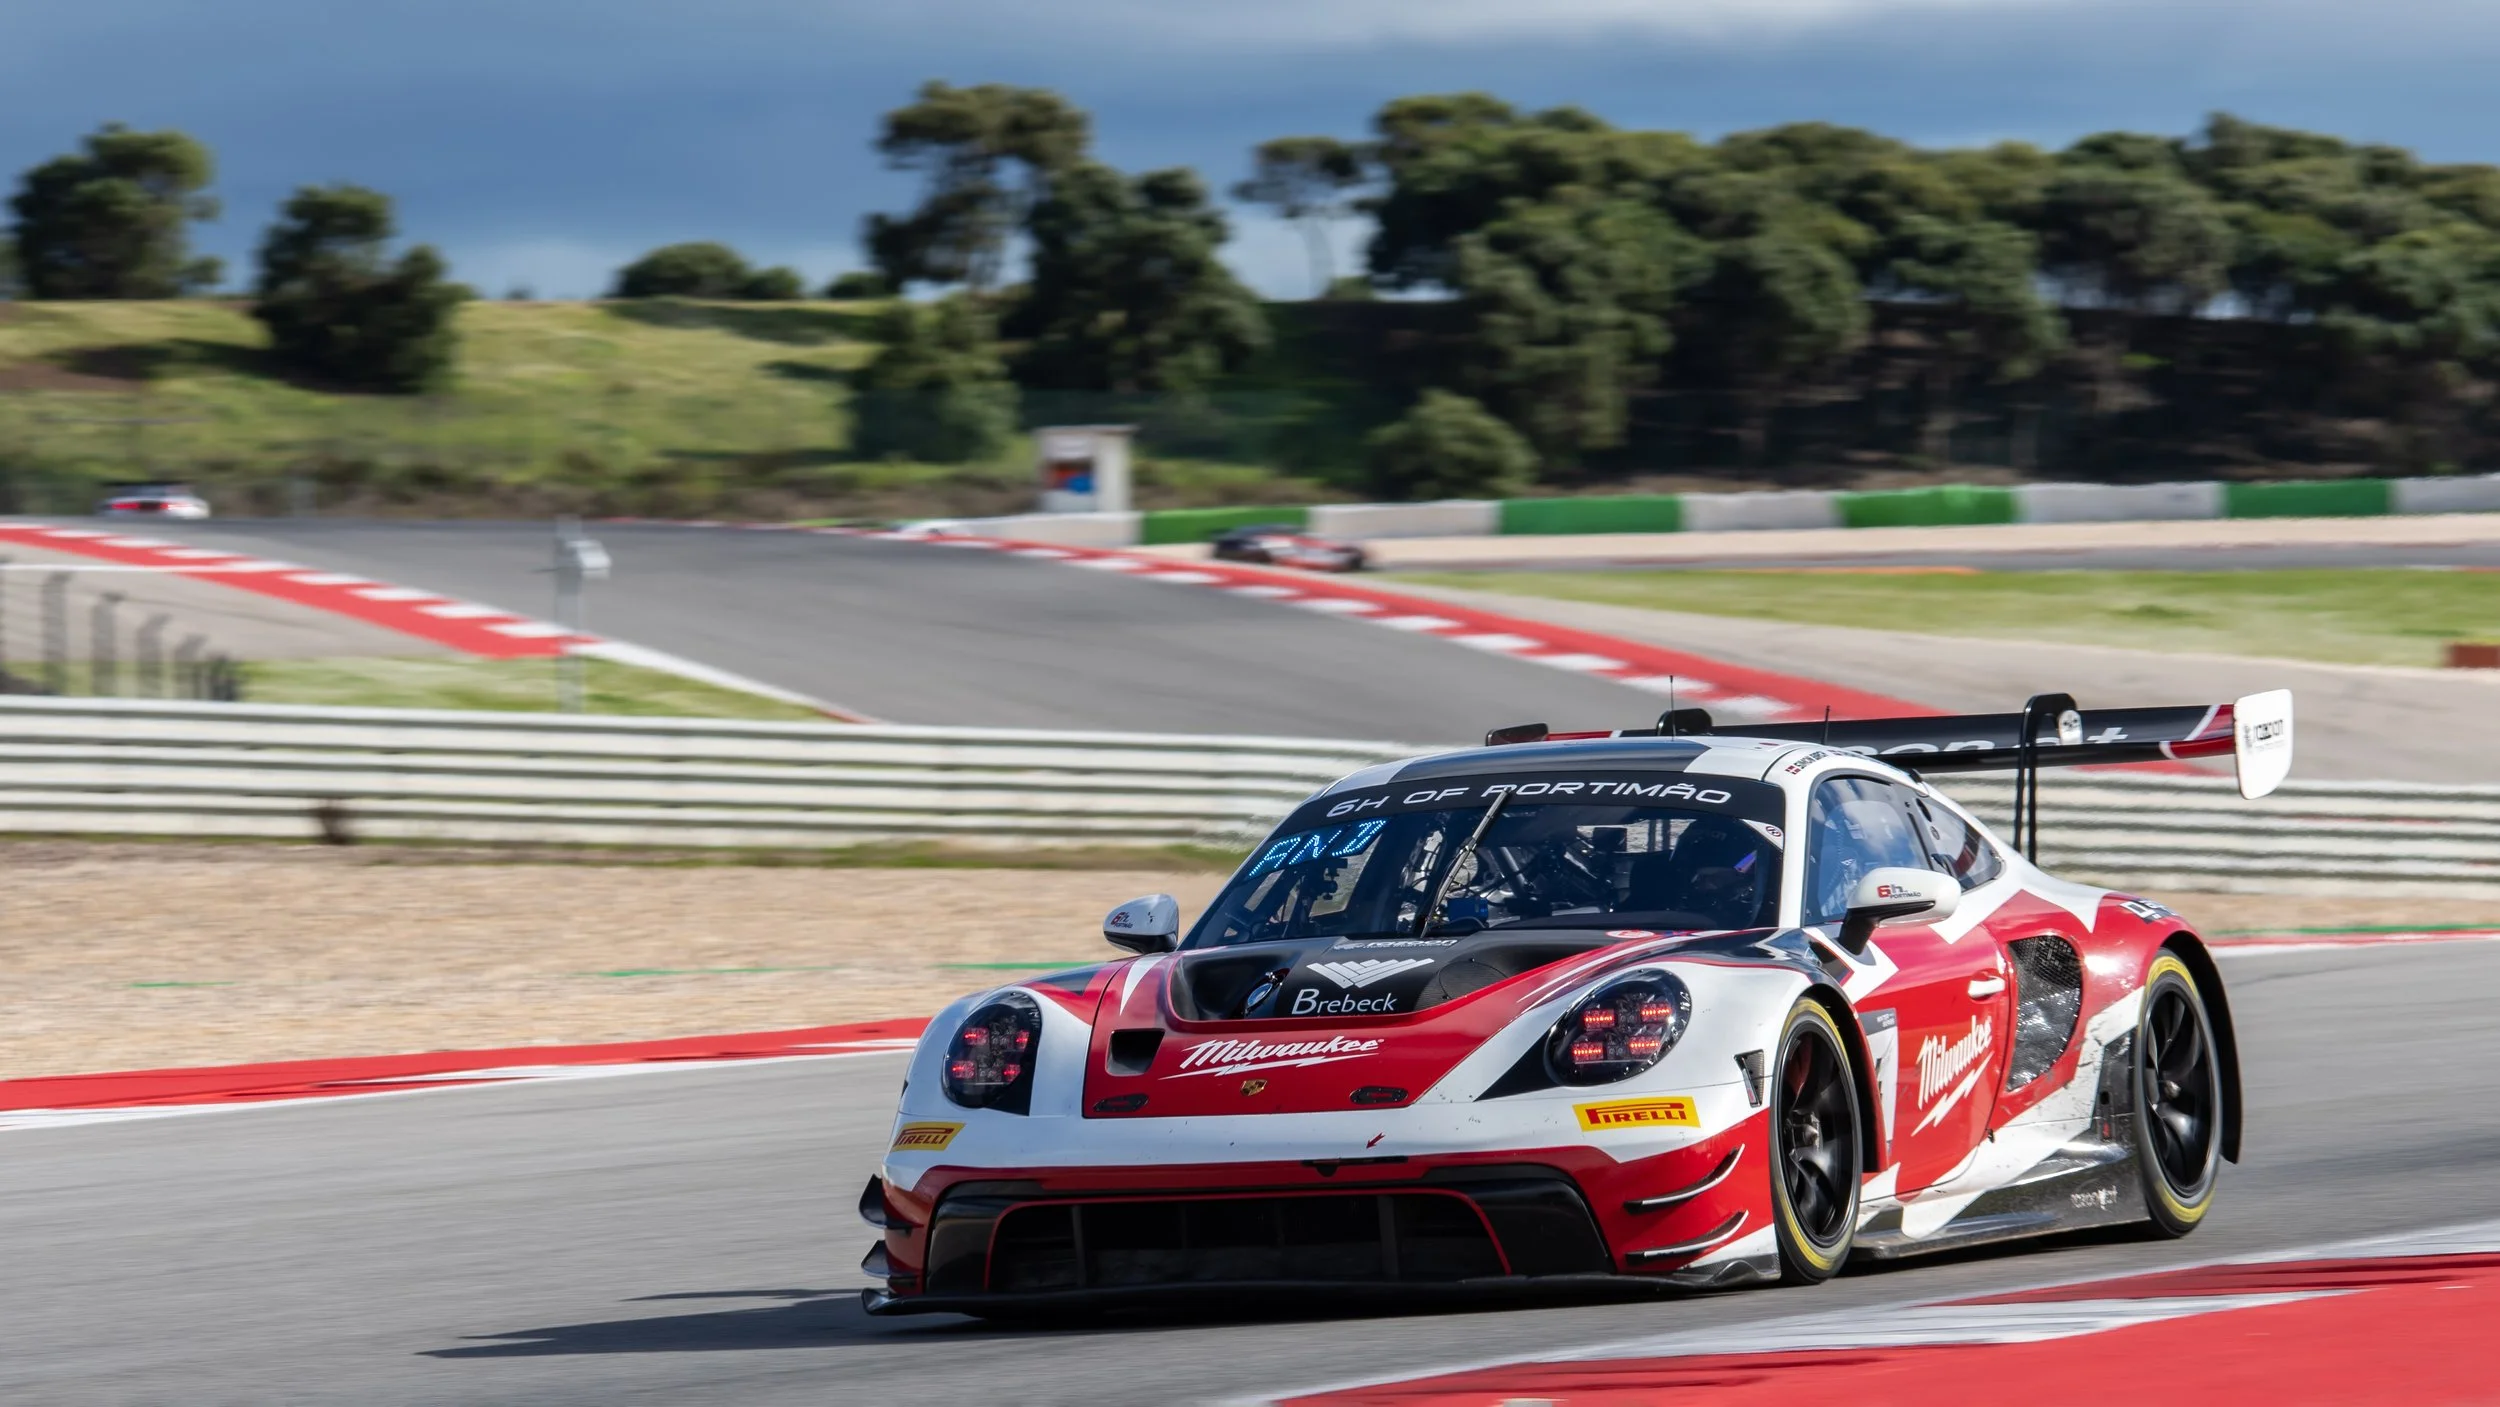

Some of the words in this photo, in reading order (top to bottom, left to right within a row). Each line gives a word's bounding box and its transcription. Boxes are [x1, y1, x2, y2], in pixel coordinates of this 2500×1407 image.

[1326, 796, 1389, 817] 6H
[1403, 787, 1470, 804] OF
[1481, 782, 1731, 804] PORTIMÃO
[1248, 818, 1387, 877] AND
[1291, 988, 1398, 1015] Brebeck
[1179, 1035, 1379, 1070] Milwaukee
[1915, 1014, 1993, 1111] Milwaukee
[1585, 1102, 1687, 1125] PIRELLI
[893, 1127, 955, 1148] PIRELLI
